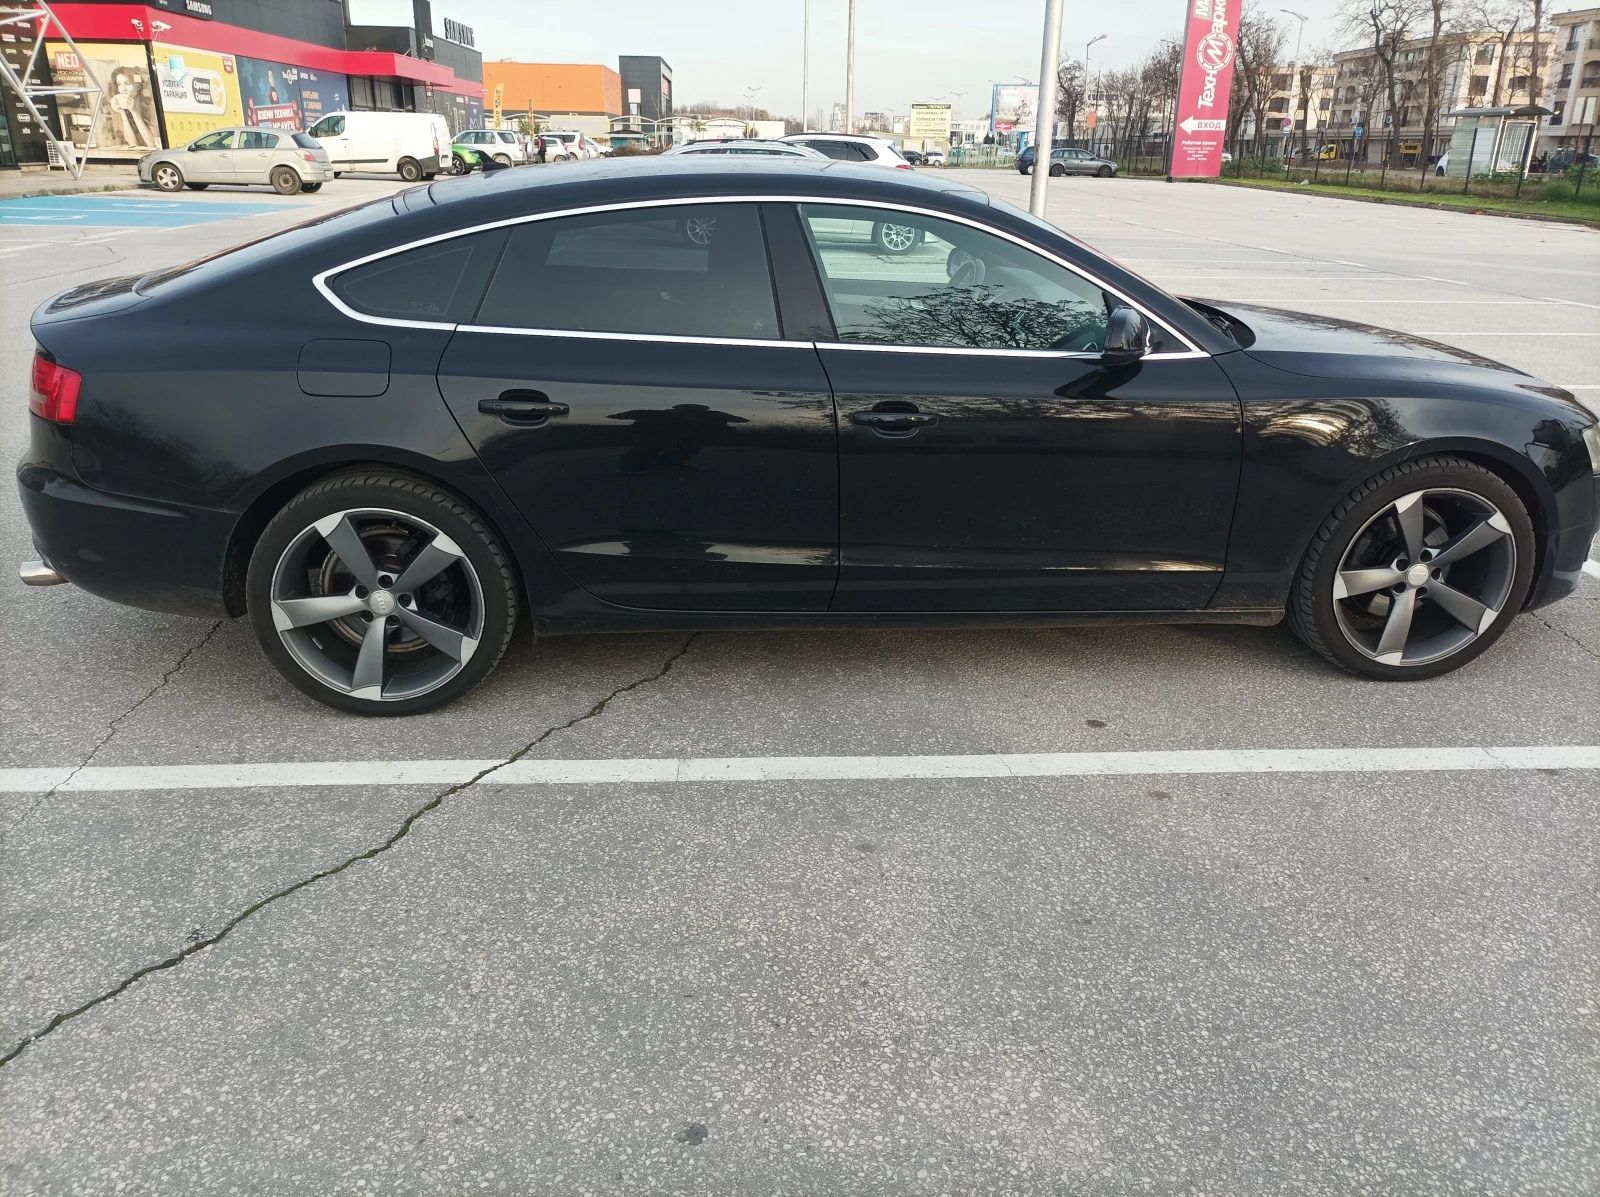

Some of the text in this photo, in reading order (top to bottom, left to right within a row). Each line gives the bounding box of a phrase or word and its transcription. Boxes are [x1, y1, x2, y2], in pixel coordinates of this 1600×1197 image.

[185, 0, 213, 16] SAMSUNG
[444, 17, 475, 48] SAMSUNG
[1197, 121, 1222, 130] ВХОД
